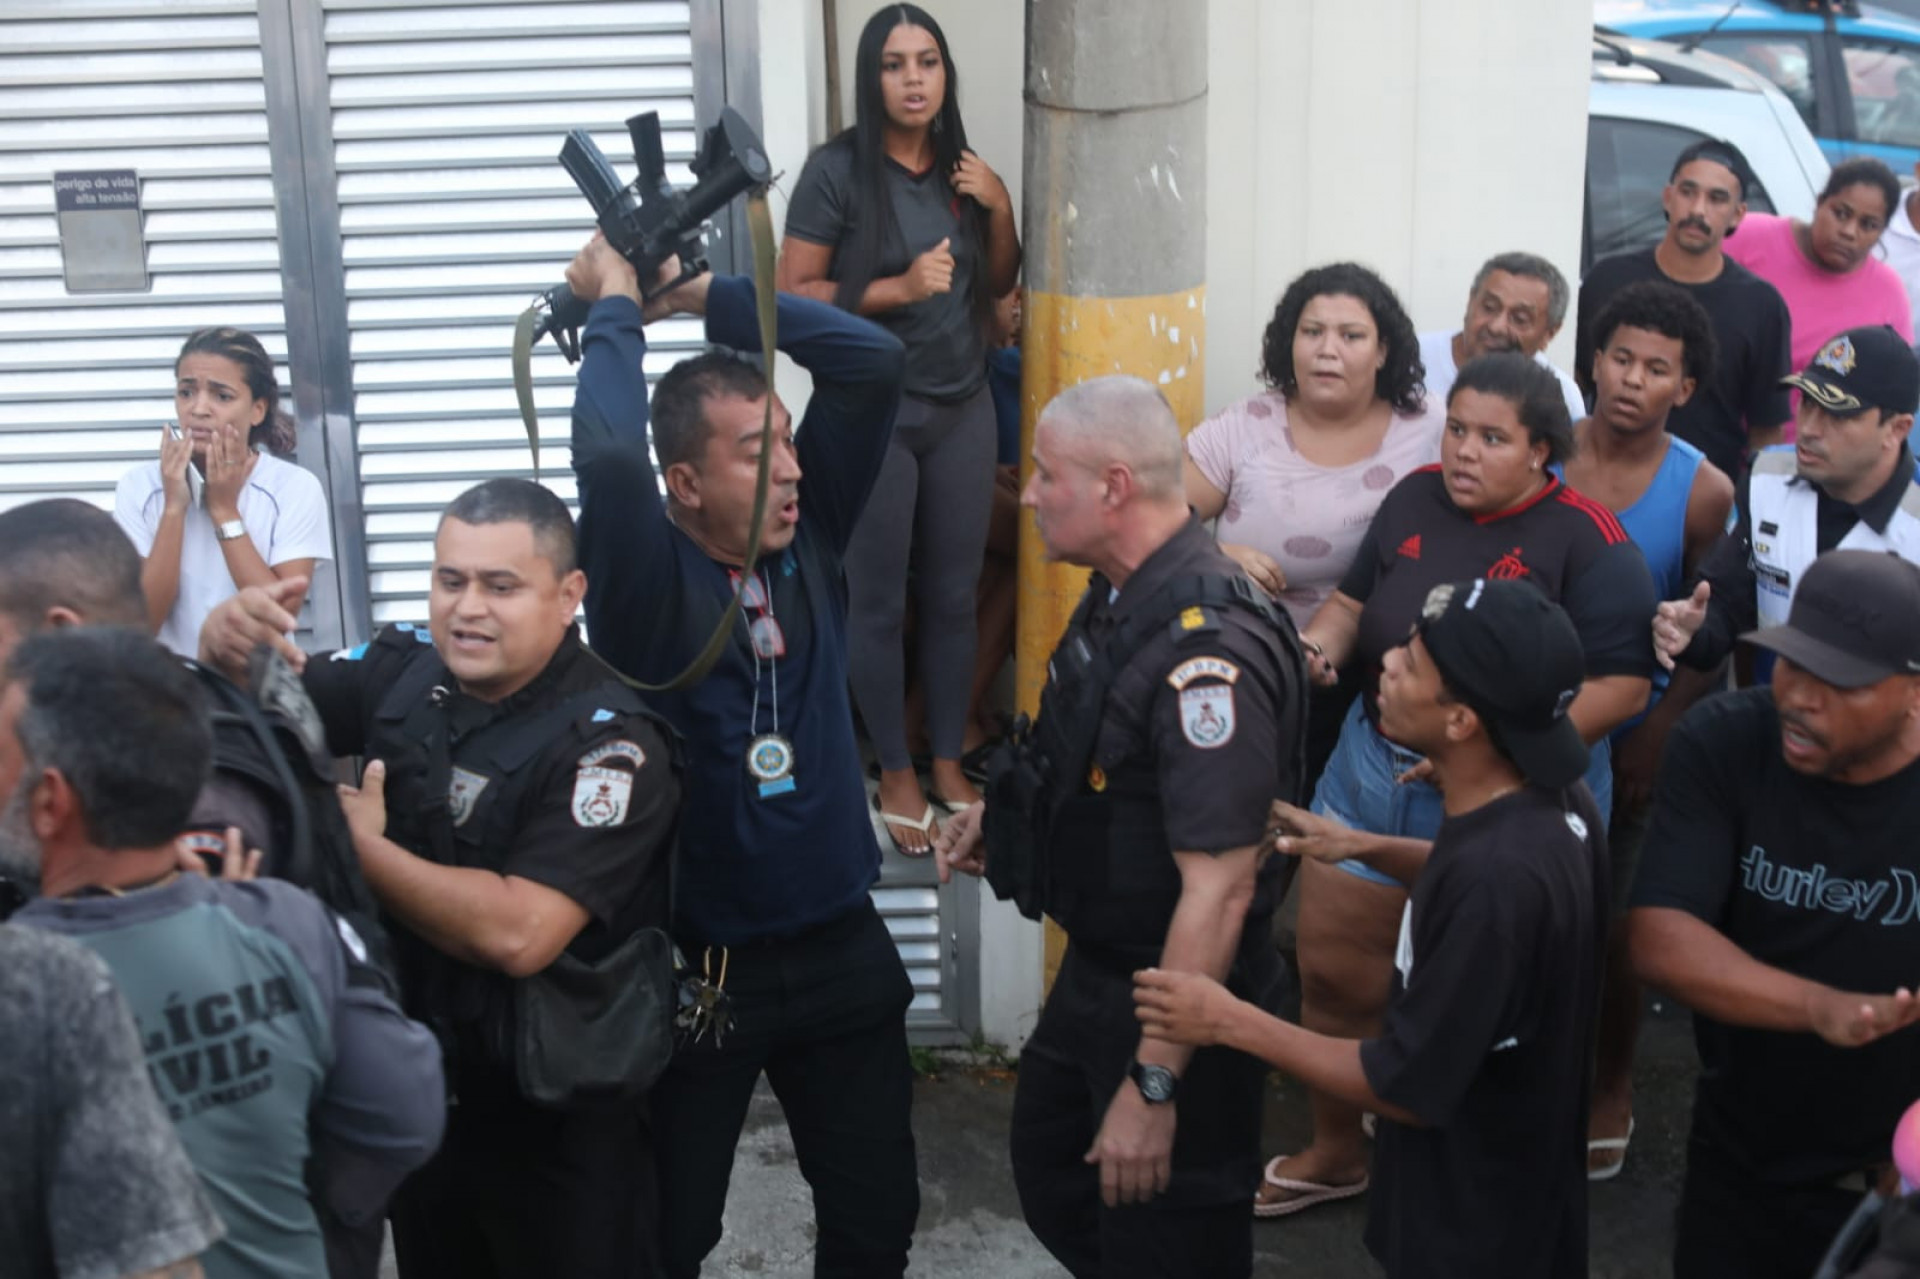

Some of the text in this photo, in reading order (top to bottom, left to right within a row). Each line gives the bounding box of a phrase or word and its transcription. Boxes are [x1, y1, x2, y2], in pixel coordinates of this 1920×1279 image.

[56, 175, 135, 192] perigo de vida
[134, 976, 299, 1054] ÍCIA
[148, 1035, 271, 1100] VIL
